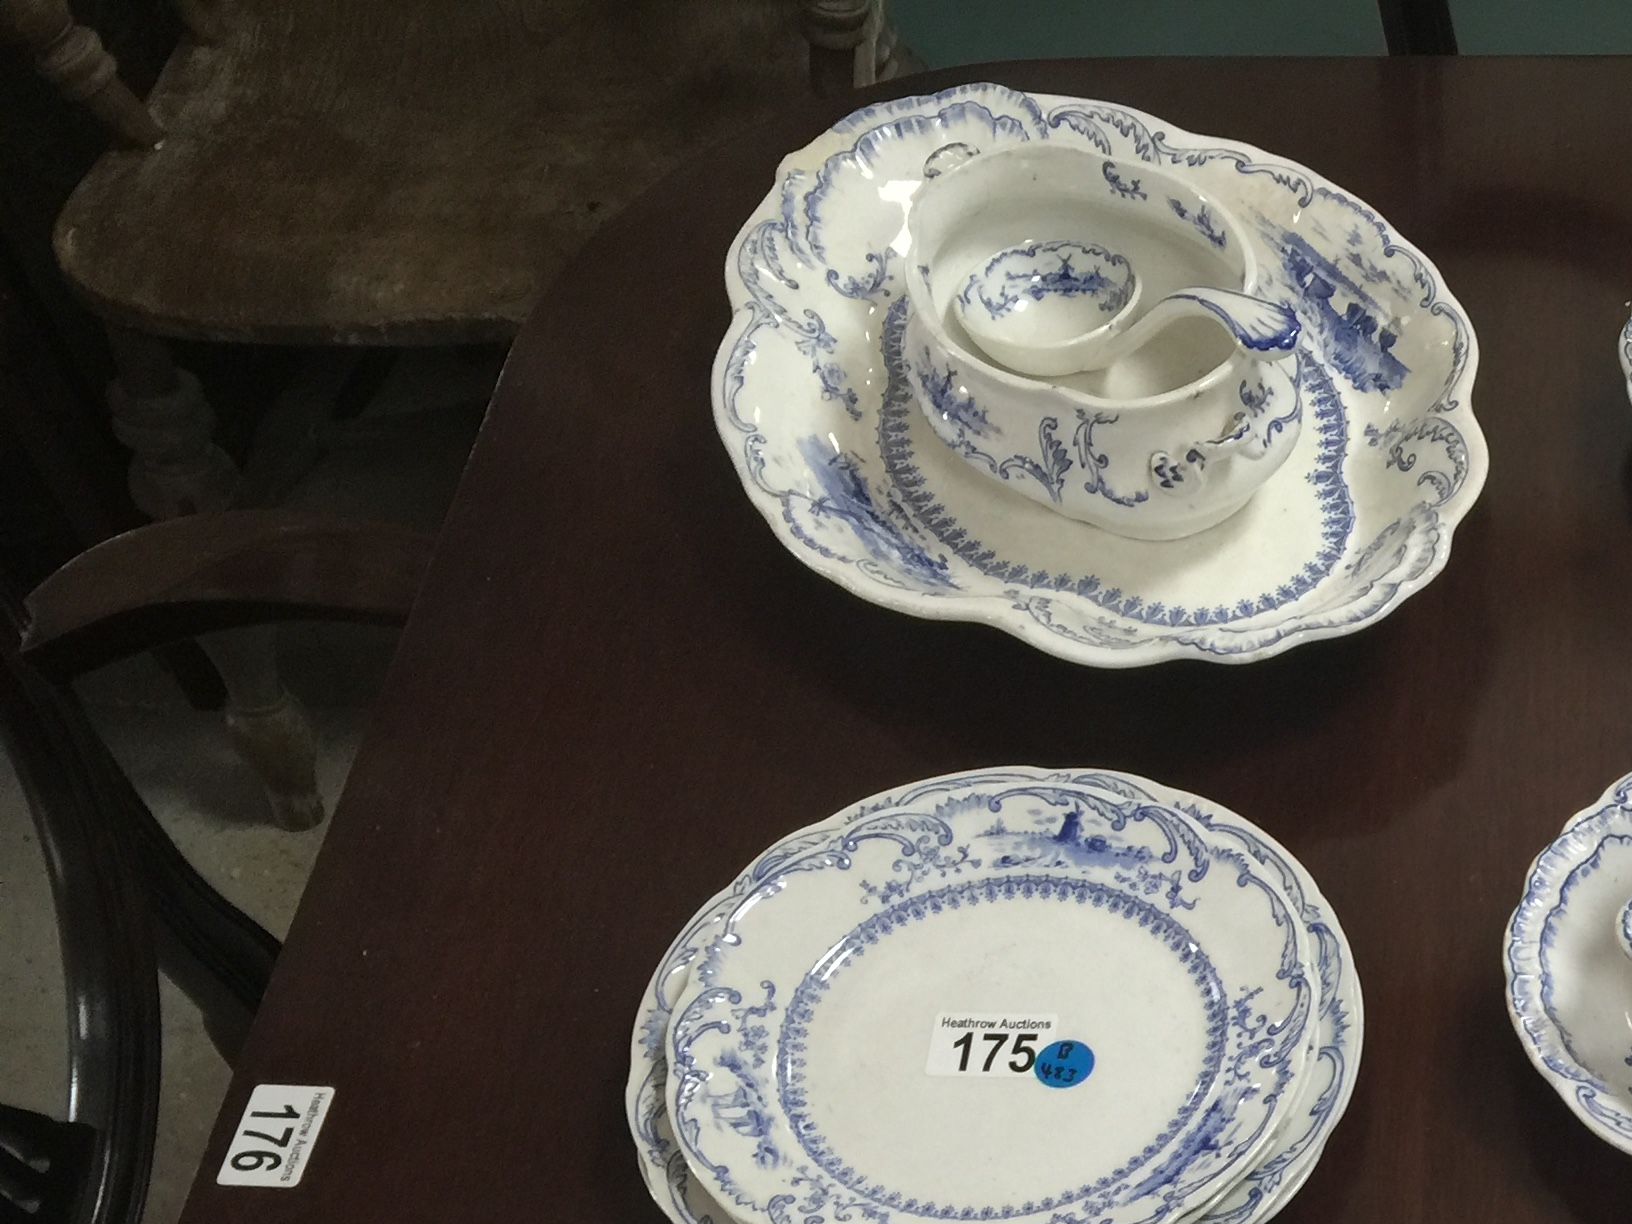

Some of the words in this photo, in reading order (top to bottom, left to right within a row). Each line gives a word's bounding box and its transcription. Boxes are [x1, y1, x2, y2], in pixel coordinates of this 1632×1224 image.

[941, 1017, 997, 1030] Heathrow
[999, 1017, 1052, 1030] Auctions
[953, 1032, 1039, 1074] 175
[298, 1092, 327, 1136] Heathrow
[230, 1104, 301, 1172] 176
[280, 1139, 308, 1182] Auctions
